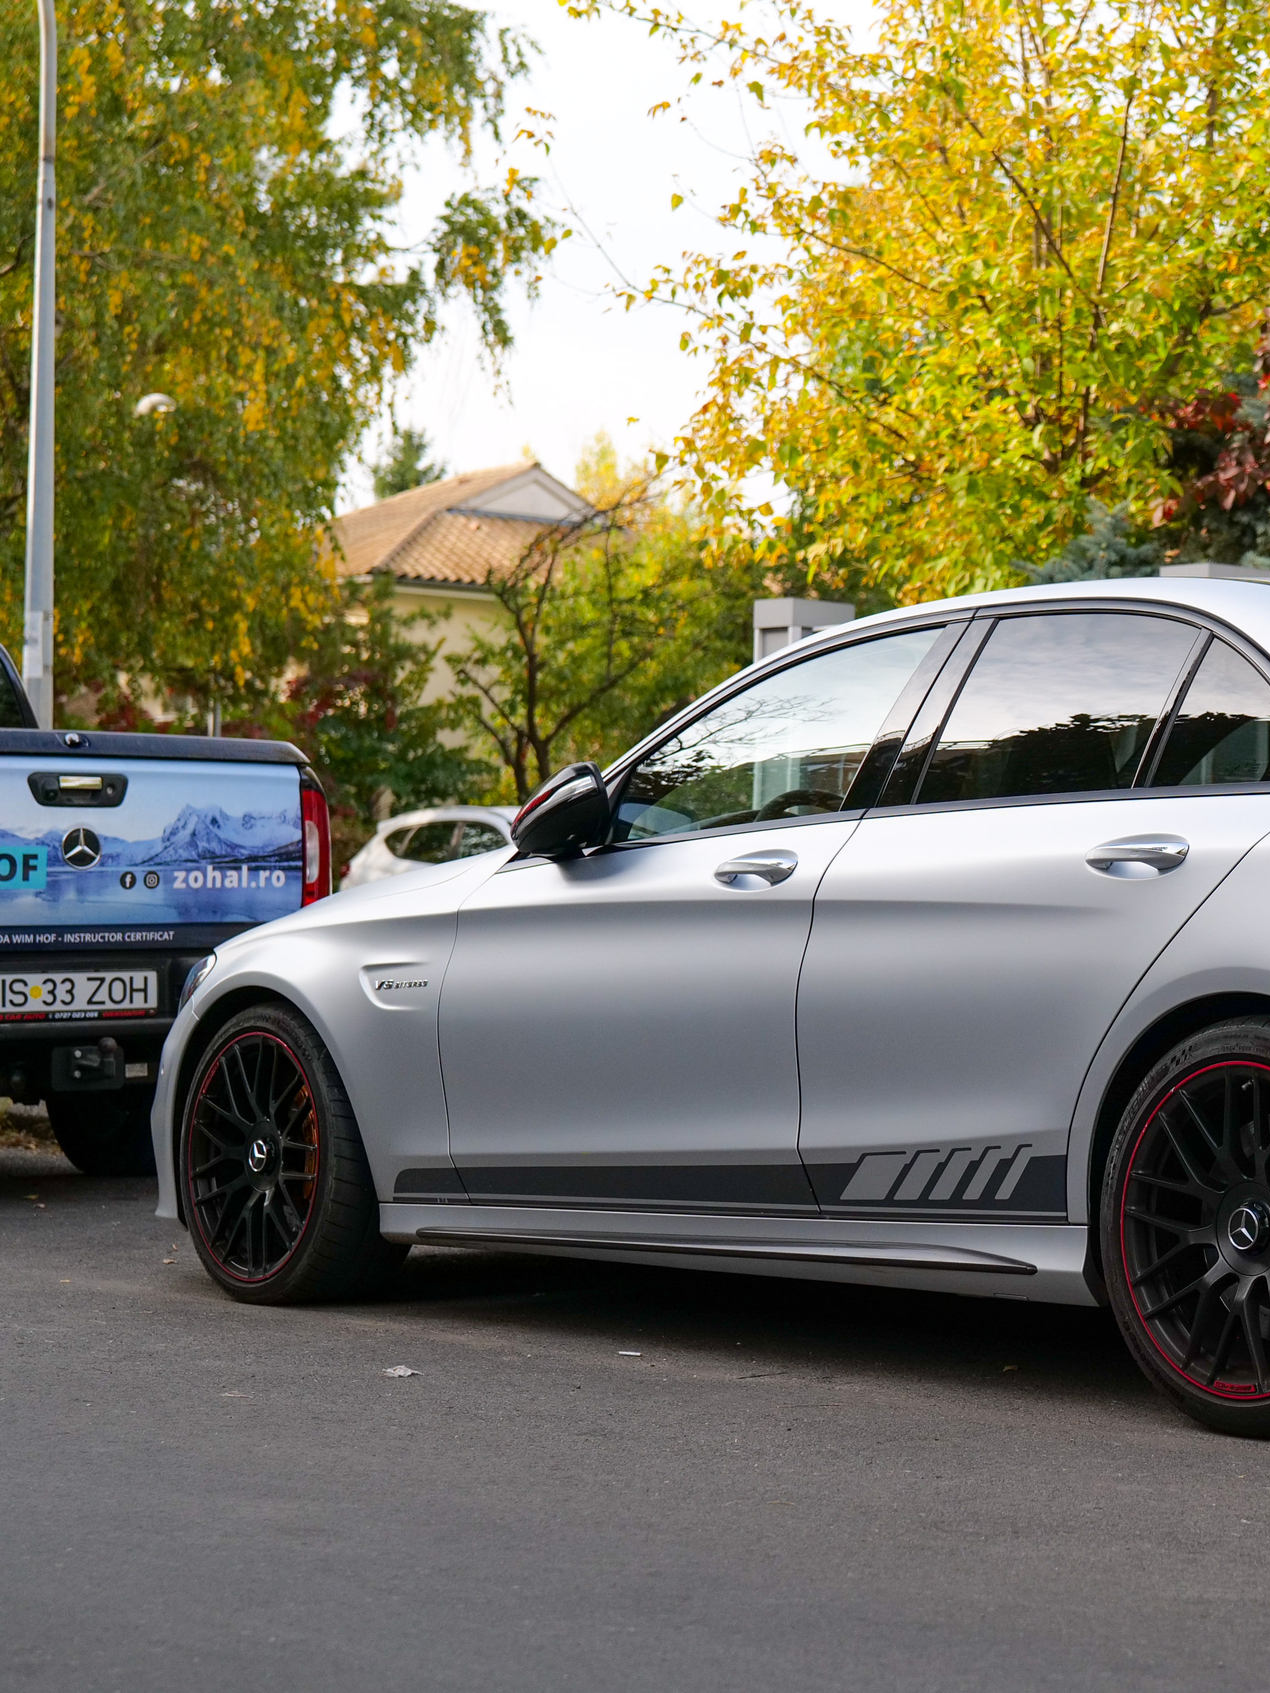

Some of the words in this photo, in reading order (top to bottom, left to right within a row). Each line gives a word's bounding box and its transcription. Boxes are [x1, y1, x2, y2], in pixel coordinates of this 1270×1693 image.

[173, 865, 286, 889] zohal.ro
[12, 933, 34, 944] WIM
[36, 933, 57, 943] HOF
[64, 932, 123, 943] INSTRUCTOR
[125, 931, 175, 942] CERTIFICAT
[1, 978, 29, 1008] IS
[42, 977, 75, 1006] 33
[86, 976, 149, 1006] ZOH
